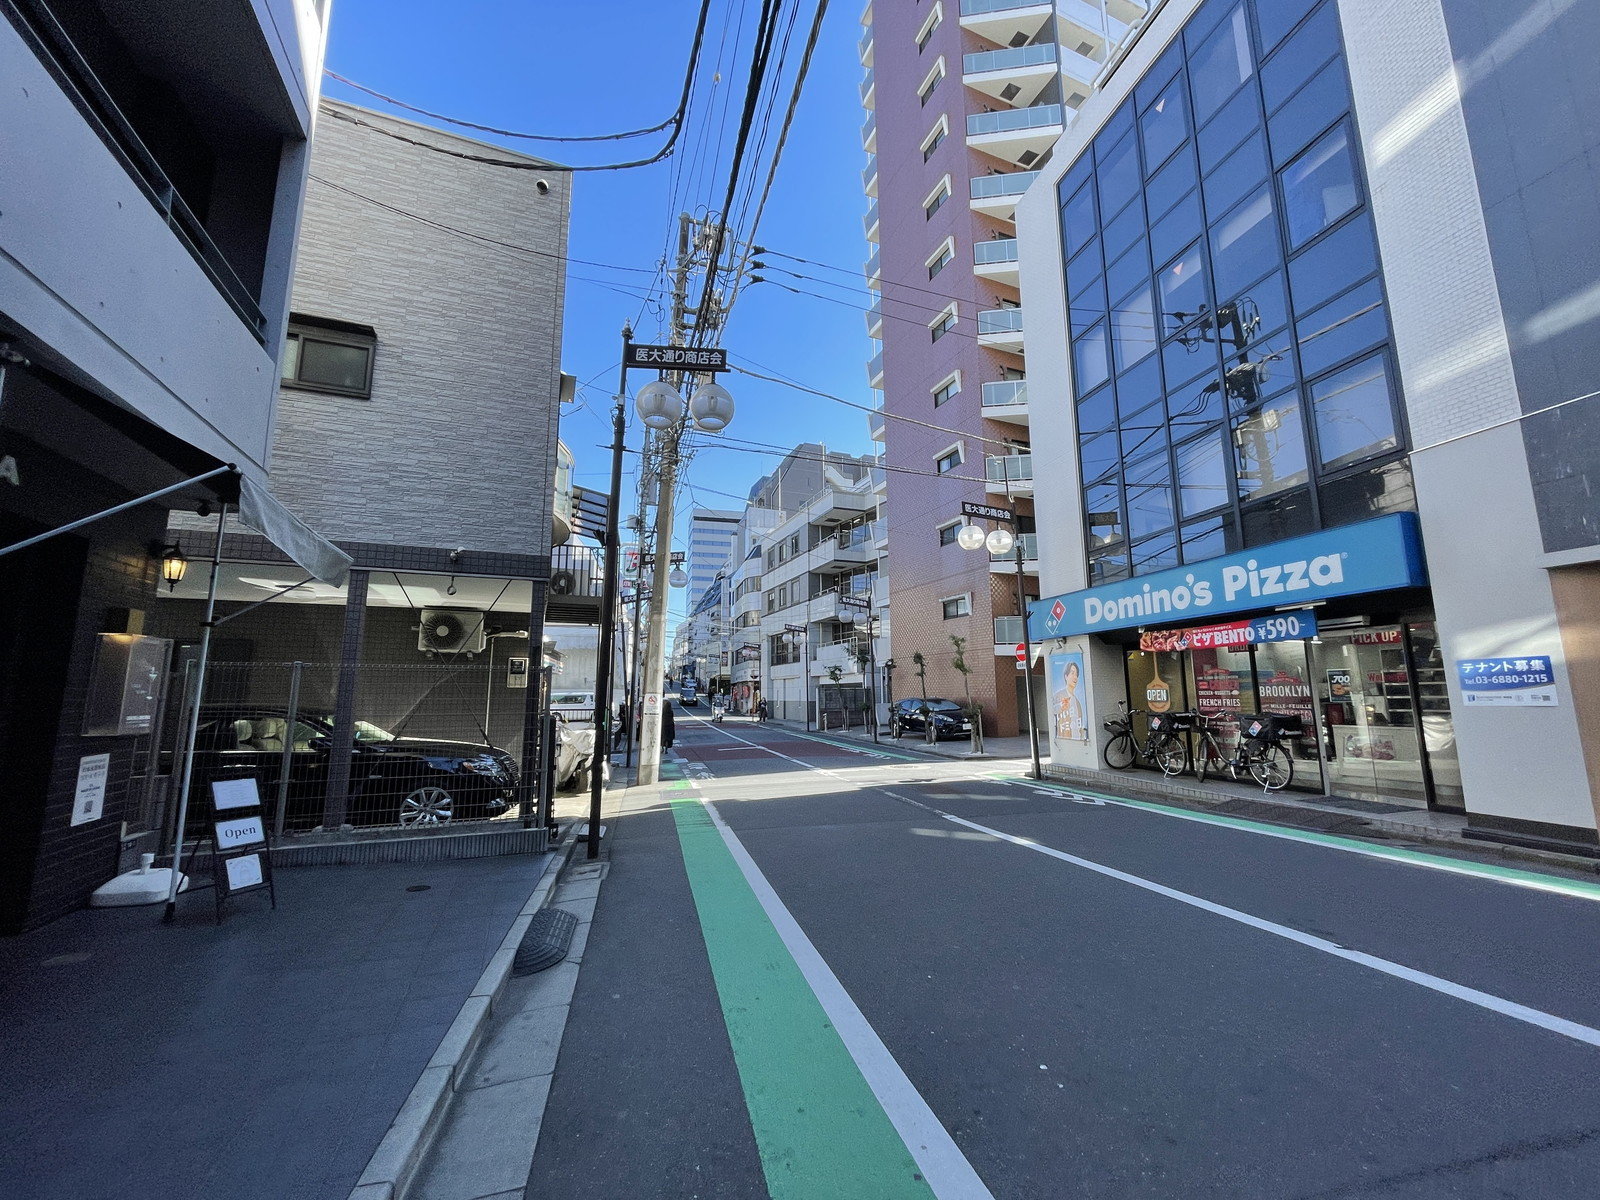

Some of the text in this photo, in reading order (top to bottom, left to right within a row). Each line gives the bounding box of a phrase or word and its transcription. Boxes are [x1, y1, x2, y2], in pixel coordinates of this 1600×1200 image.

[635, 347, 723, 366] 医大通り商店会
[964, 504, 1011, 520] 医大通り商店会
[1084, 552, 1344, 625] Domino's Pizza
[1381, 631, 1398, 642] UP
[1461, 659, 1546, 674] テナント募集
[1146, 689, 1168, 701] OPEN
[1259, 685, 1311, 697] BROOKLYN
[1199, 698, 1241, 707] FRENCH FRIES
[224, 826, 257, 840] Open
